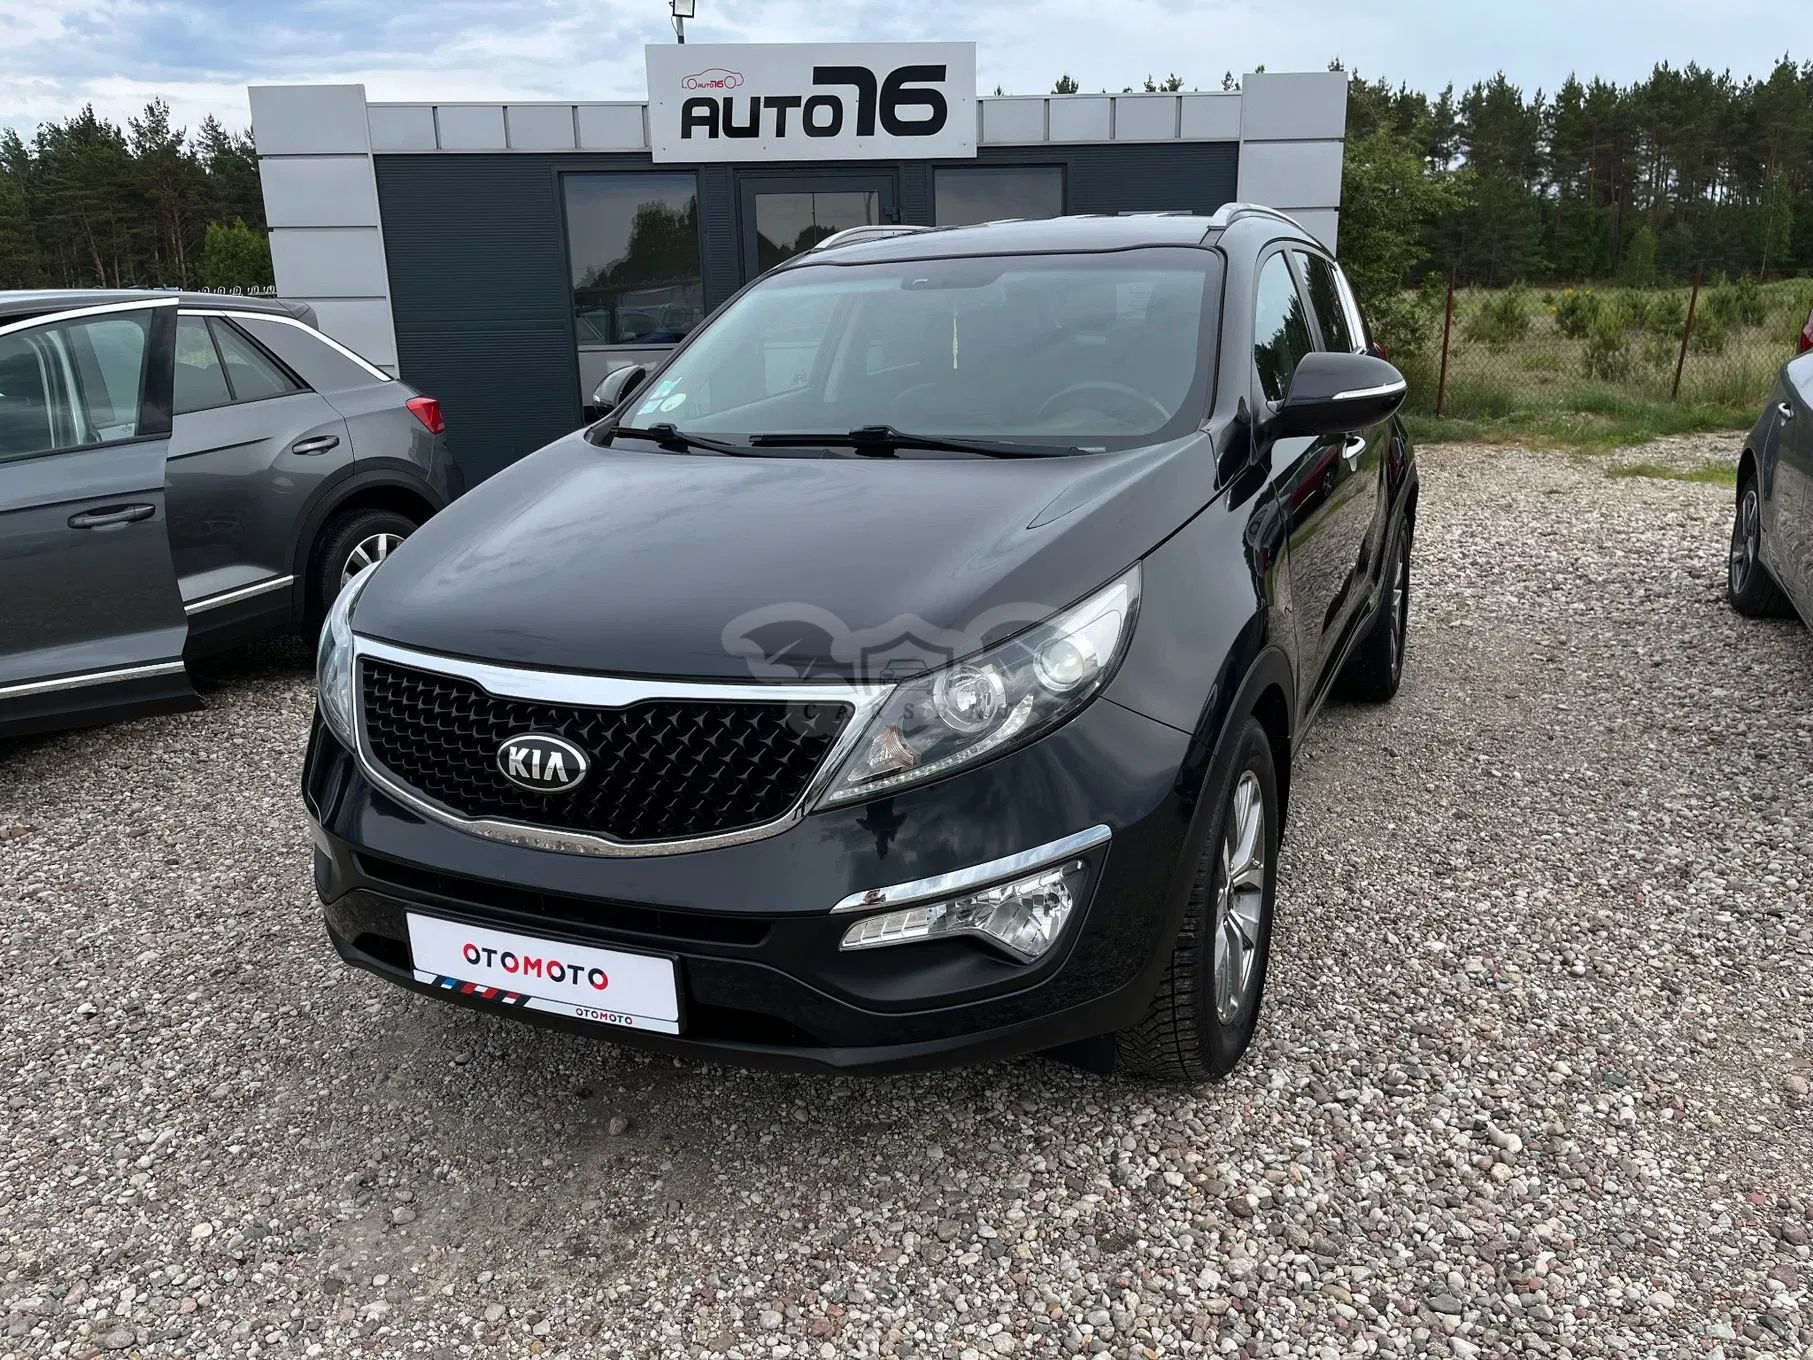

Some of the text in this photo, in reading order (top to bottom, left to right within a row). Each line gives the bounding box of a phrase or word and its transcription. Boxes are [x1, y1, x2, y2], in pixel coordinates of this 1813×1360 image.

[508, 746, 569, 782] KIA
[462, 943, 609, 991] OTOMOTO
[575, 1007, 633, 1025] OTOMOTO
